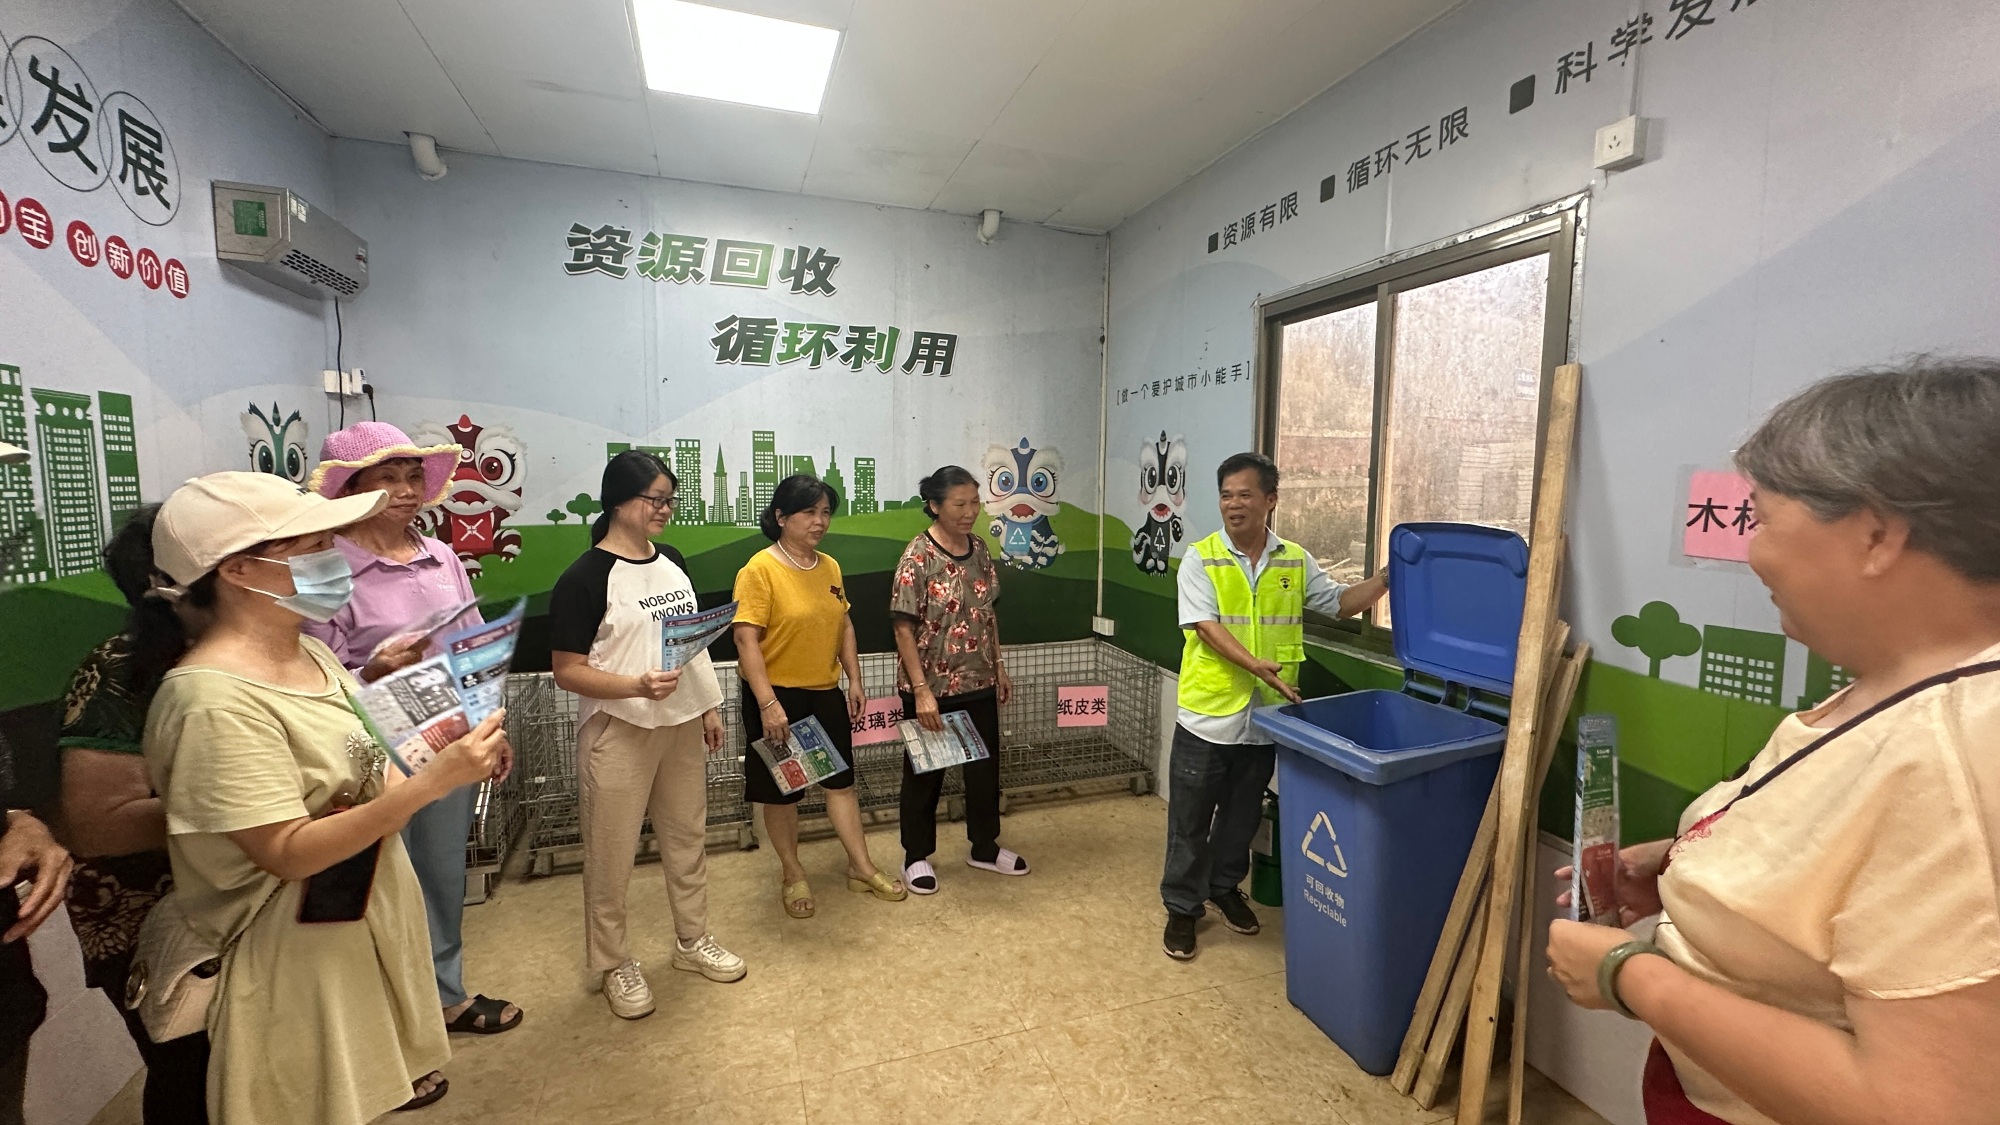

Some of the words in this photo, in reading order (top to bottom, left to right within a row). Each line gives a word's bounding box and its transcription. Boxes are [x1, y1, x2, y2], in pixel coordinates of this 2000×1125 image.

[0, 54, 171, 211] 发展
[1222, 191, 1299, 250] 资源有限
[1346, 106, 1469, 194] 循环无限
[1554, 0, 1757, 95] 科学发
[563, 222, 841, 296] 资源回收
[710, 314, 959, 377] 循环利用
[639, 589, 692, 610] NOBODY
[651, 601, 694, 622] KNOWS
[1057, 698, 1106, 716] 纸皮类
[1303, 889, 1347, 927] Recyclable
[1305, 873, 1345, 909] 可回收物
